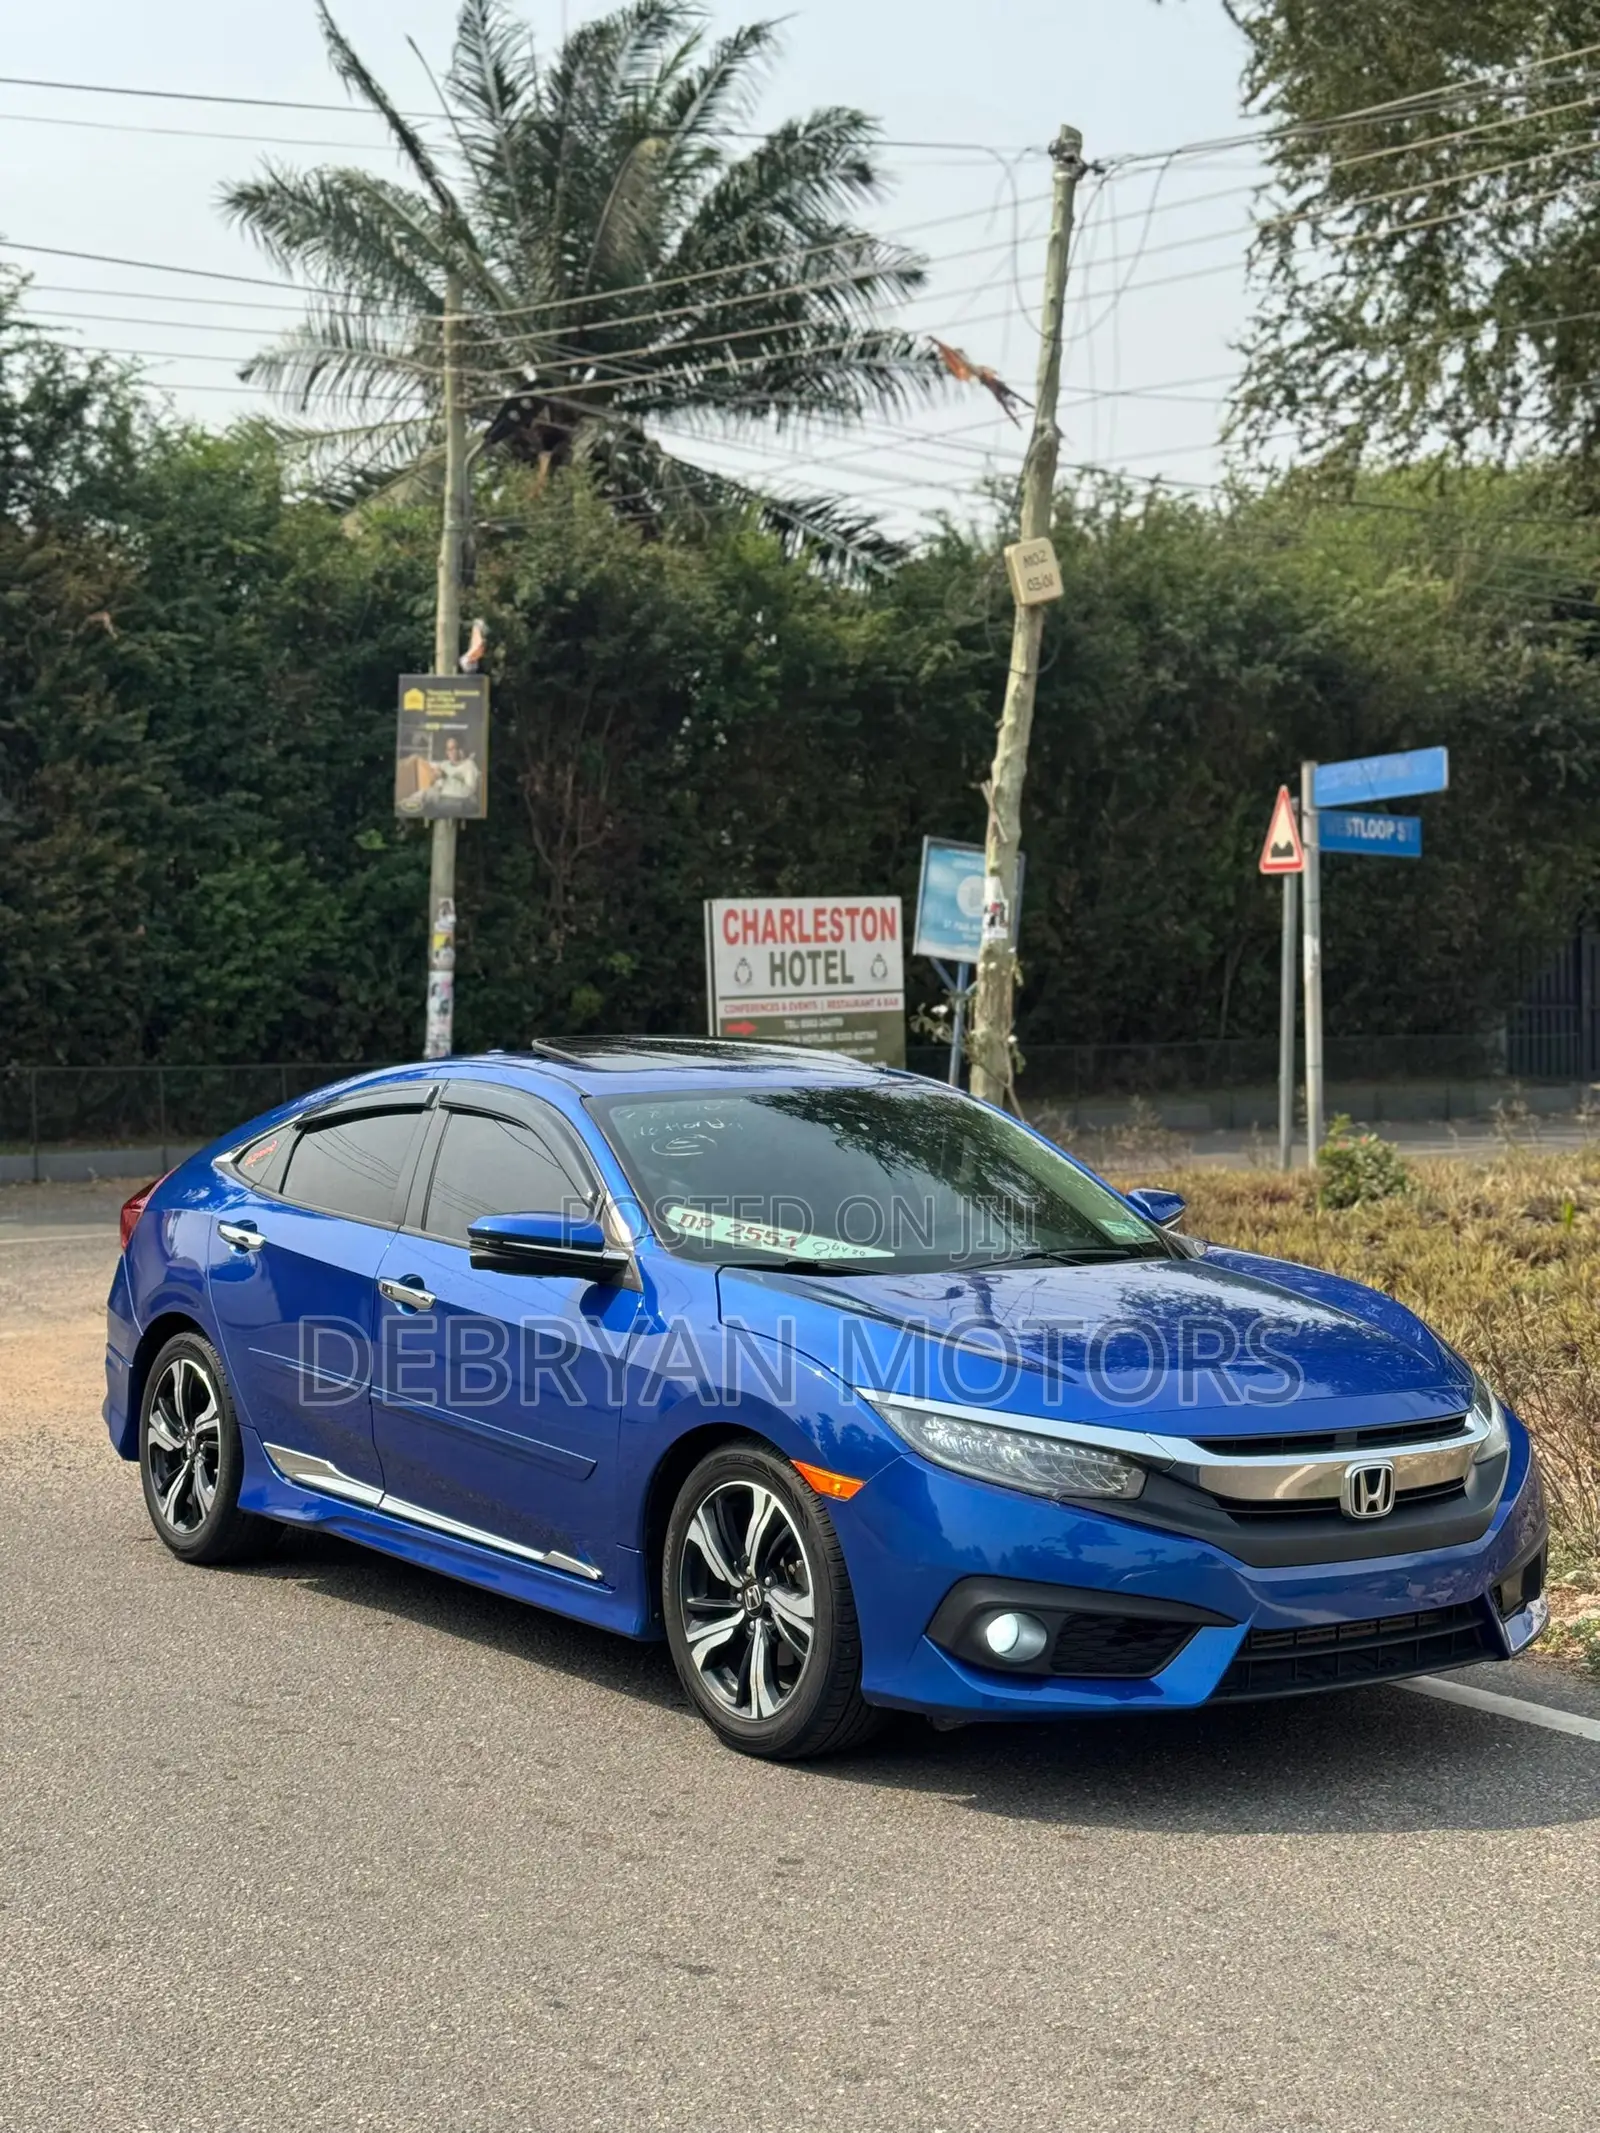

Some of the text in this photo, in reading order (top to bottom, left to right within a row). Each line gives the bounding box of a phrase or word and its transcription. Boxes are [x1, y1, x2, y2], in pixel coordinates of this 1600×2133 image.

[723, 906, 897, 945] CHARLESTON
[769, 949, 855, 987] HOTEL
[789, 1000, 818, 1012] EVENTS
[827, 998, 875, 1010] RESTAURANT
